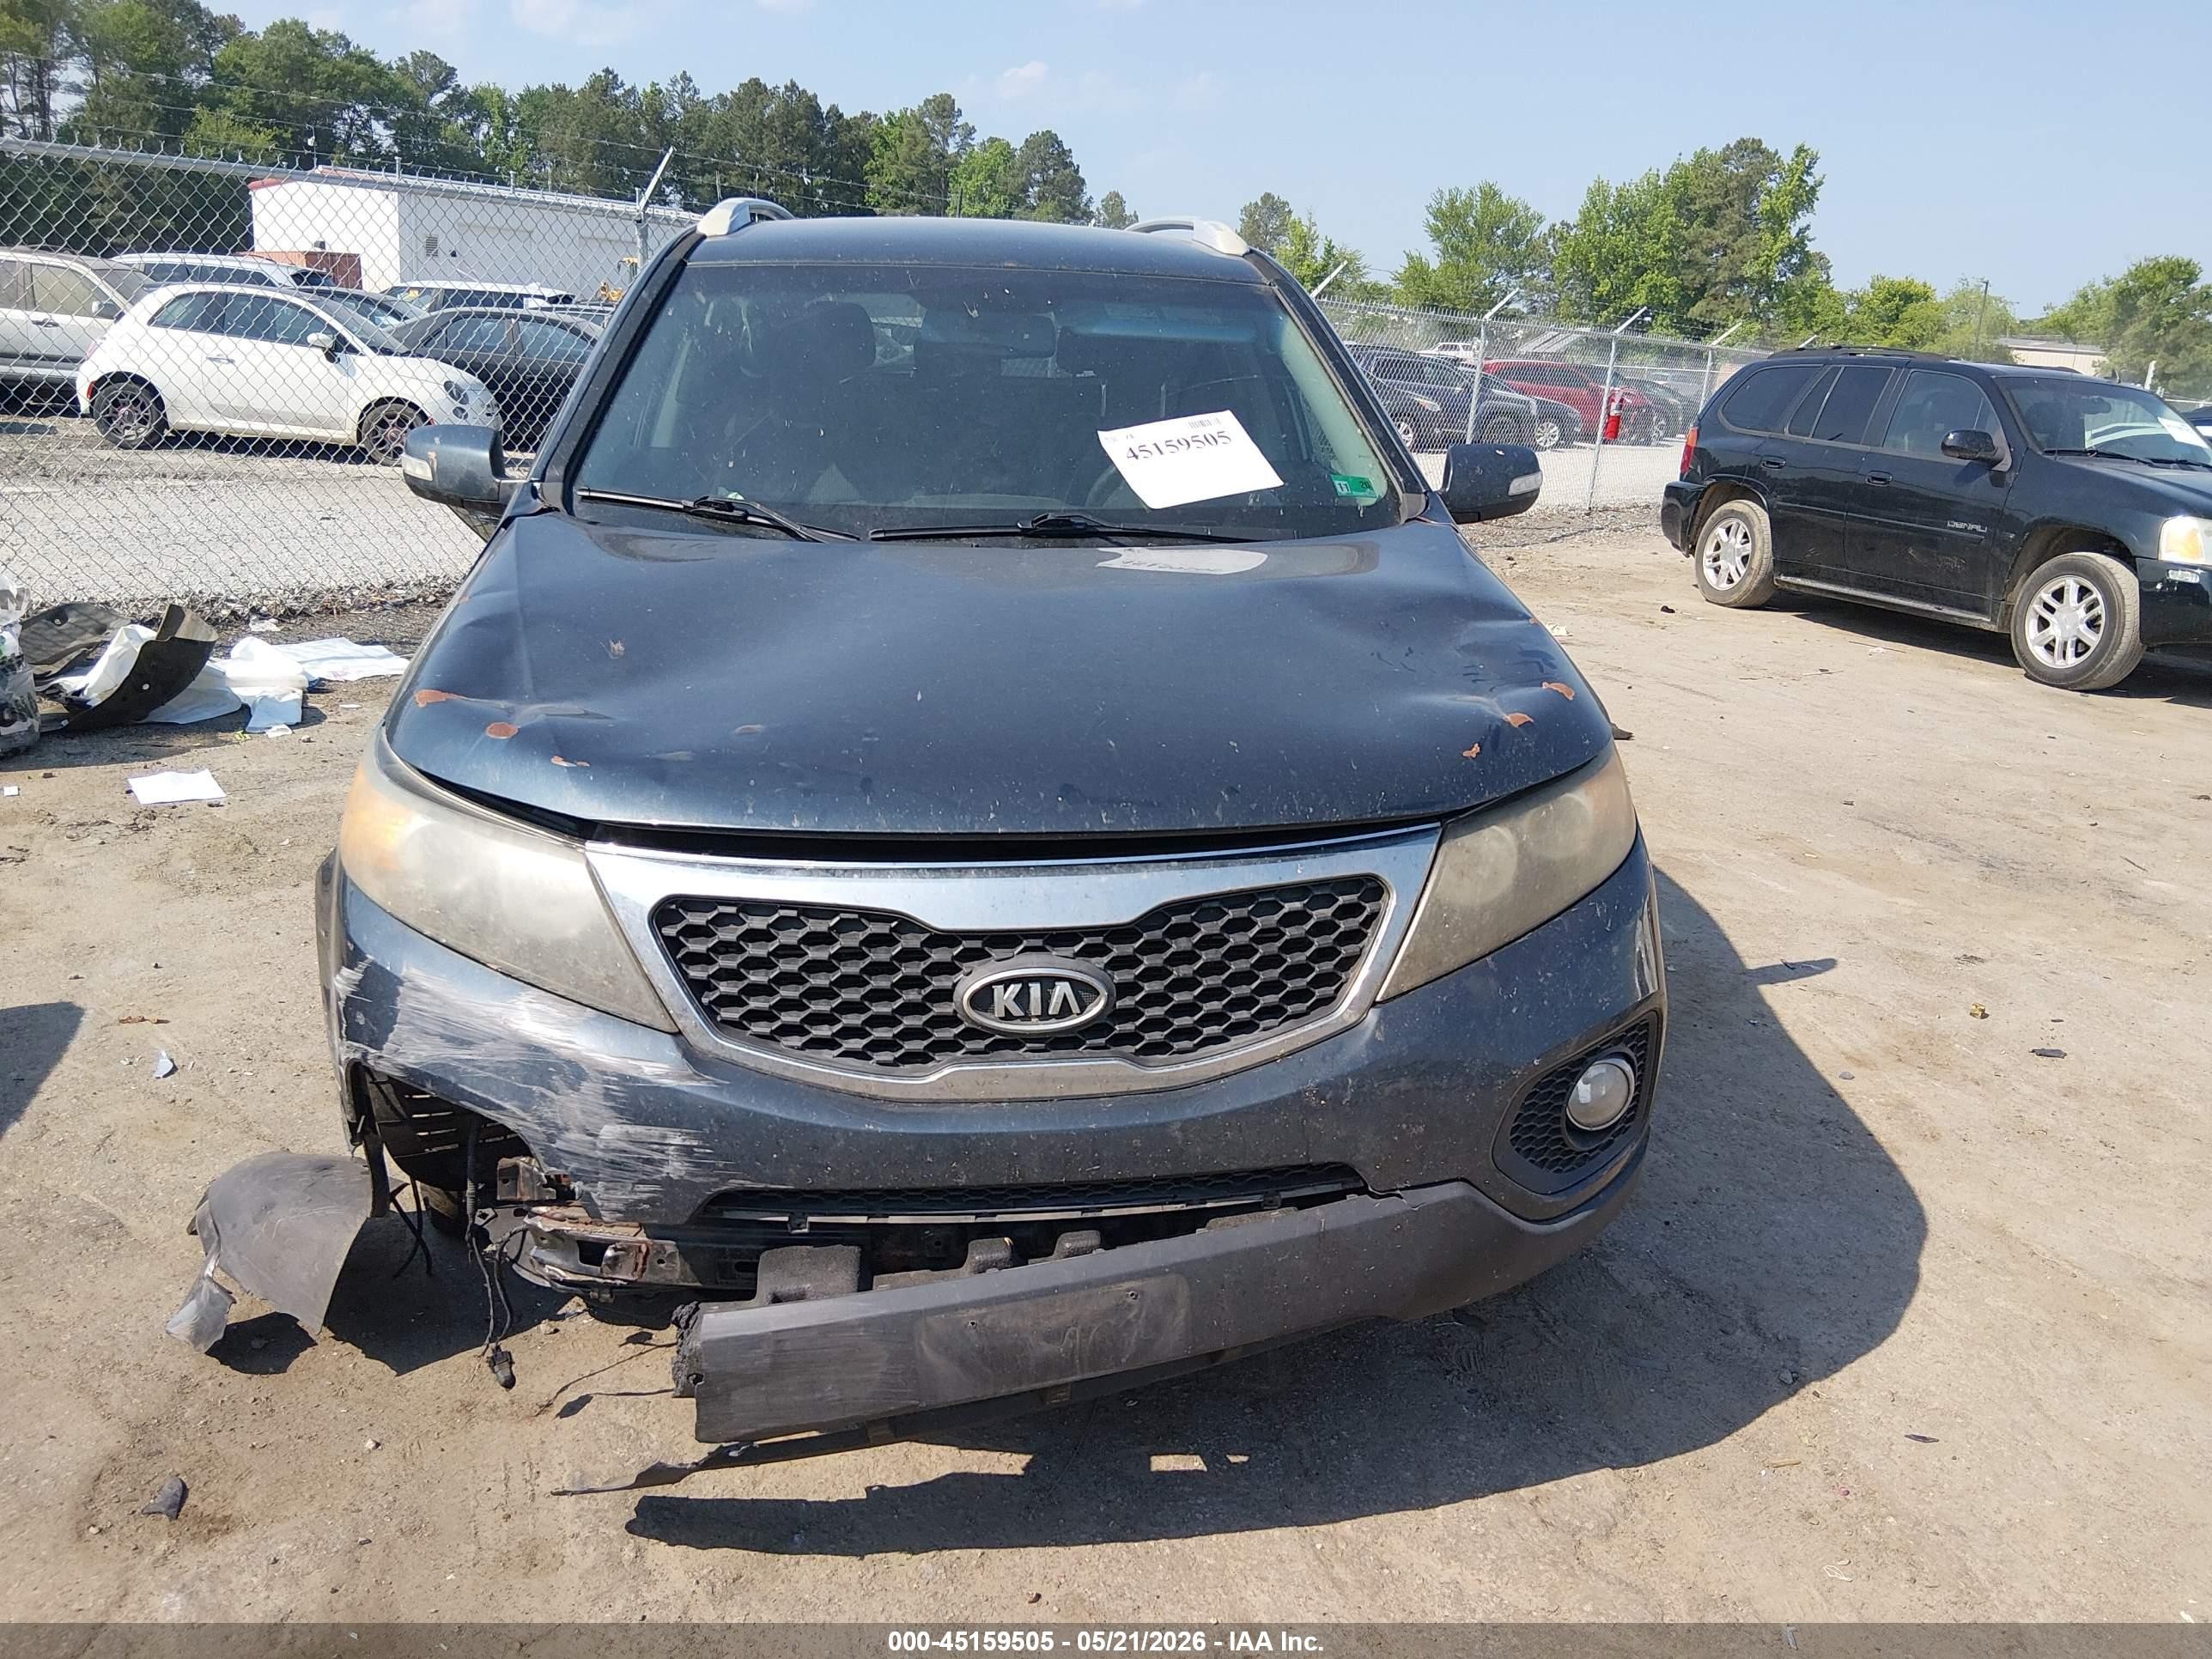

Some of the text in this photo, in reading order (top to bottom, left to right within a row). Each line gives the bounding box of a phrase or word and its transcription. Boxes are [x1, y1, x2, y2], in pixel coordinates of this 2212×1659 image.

[1126, 430, 1232, 460] 45159505
[1947, 520, 1988, 533] DENALI
[992, 981, 1081, 1018] KIA
